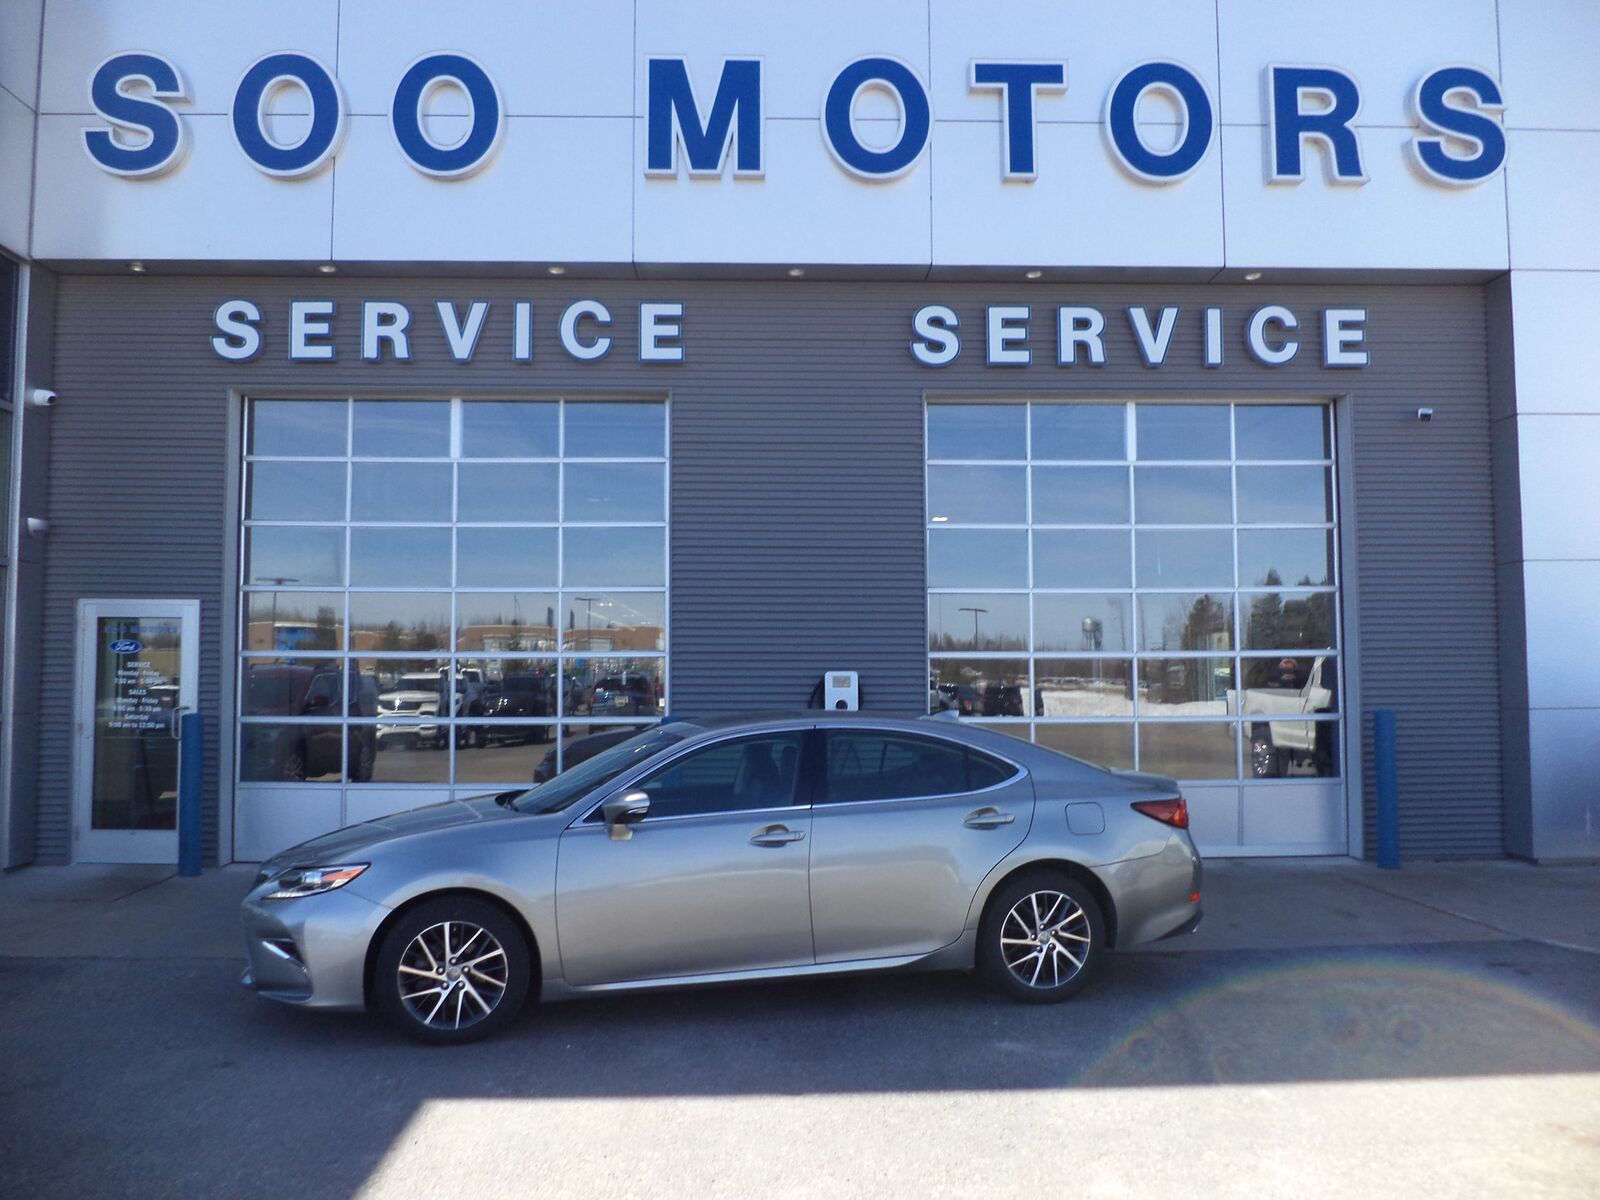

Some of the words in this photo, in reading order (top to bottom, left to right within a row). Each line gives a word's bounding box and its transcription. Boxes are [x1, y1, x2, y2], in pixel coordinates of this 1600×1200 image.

[82, 50, 502, 180] SOO
[644, 54, 1508, 188] MOTORS
[210, 299, 686, 363] SERVICE
[910, 305, 1370, 368] SERVICE
